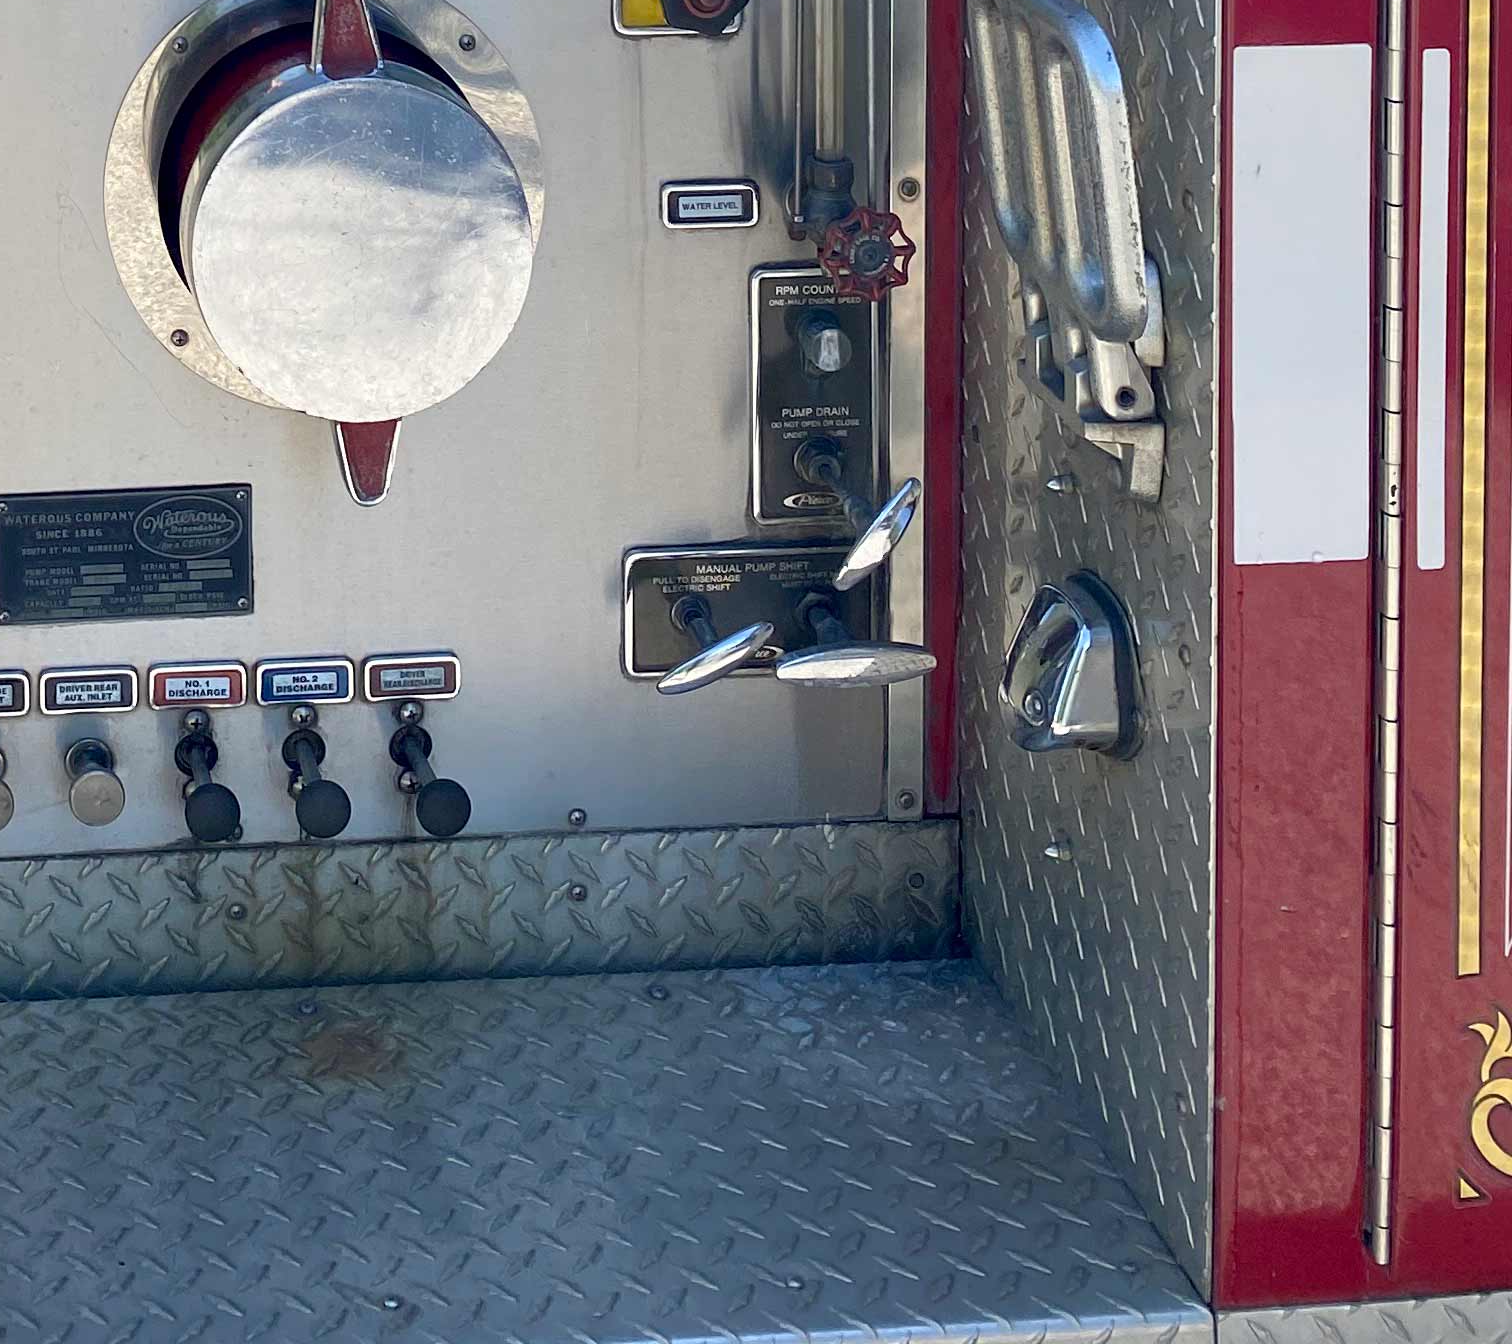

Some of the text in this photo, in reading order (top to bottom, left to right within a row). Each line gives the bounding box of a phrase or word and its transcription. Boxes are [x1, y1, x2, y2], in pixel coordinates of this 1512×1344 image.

[682, 202, 711, 210] WATER
[782, 407, 849, 417] PUMP DRAIN
[696, 561, 808, 573] MANUAL PUMP SHIFT
[185, 680, 201, 688] NO.
[276, 684, 334, 692] DISCHARGE
[168, 689, 227, 697] DISCHARGE
